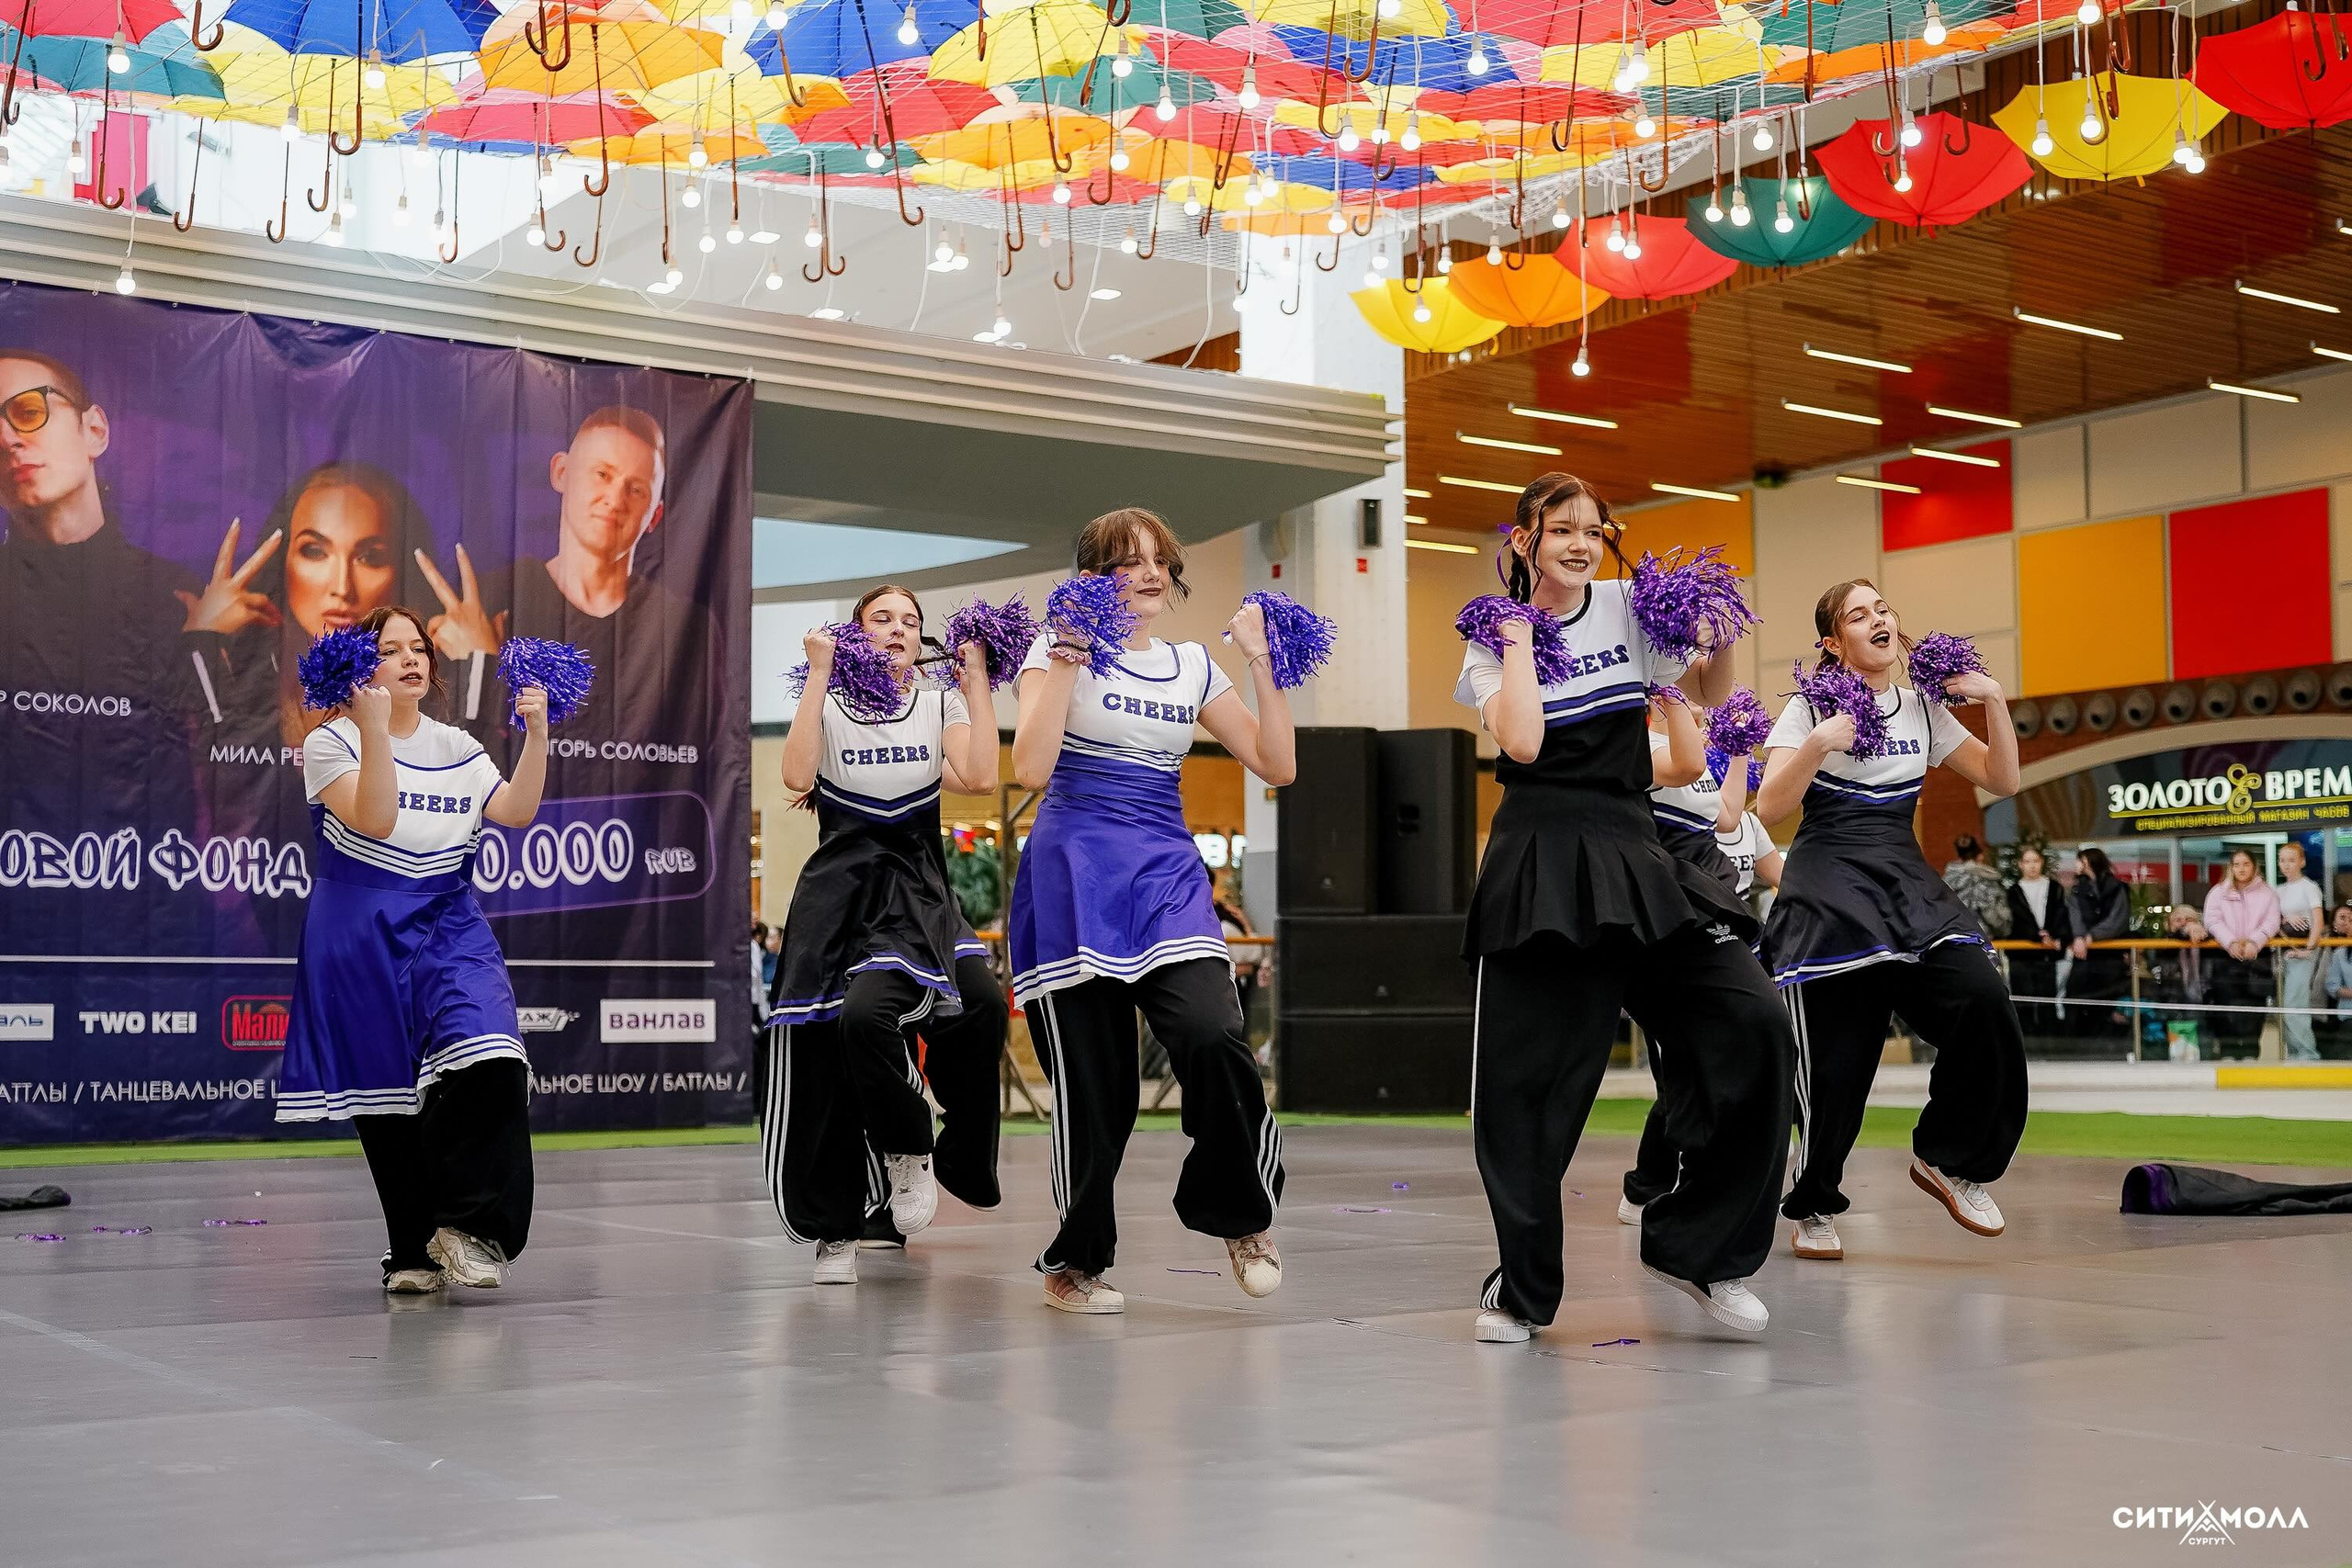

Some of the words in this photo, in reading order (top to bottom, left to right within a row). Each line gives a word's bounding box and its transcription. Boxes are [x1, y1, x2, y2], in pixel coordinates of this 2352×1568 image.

[1566, 644, 1630, 679] EERS
[13, 690, 132, 716] СОКОЛОВ
[1102, 693, 1194, 725] CHEERS
[209, 744, 275, 766] МИЛА
[280, 746, 304, 767] РЕ
[547, 738, 597, 759] ГОРЬ
[600, 740, 699, 764] СОЛОВЬЕВ
[841, 744, 930, 766] CHEERS
[2264, 765, 2352, 800] ВРЕМ
[399, 791, 471, 815] HEERS
[2258, 807, 2310, 824] МАГАЗИН
[0, 827, 141, 890] ОВОЙ
[148, 828, 312, 899] ФОНД
[471, 818, 635, 893] 0.000
[644, 847, 697, 875] RUB
[78, 1010, 147, 1035] TWO
[152, 1010, 198, 1035] KEI
[608, 1011, 707, 1030] ванлав
[0, 1081, 67, 1104] АТТЛЫ
[89, 1078, 266, 1104] ТАНЦЕВАЛЬНОЕ
[530, 1073, 594, 1095] ЛЬНОЕ
[597, 1072, 646, 1094] ШОУ
[662, 1071, 732, 1092] БАТТЛЫ
